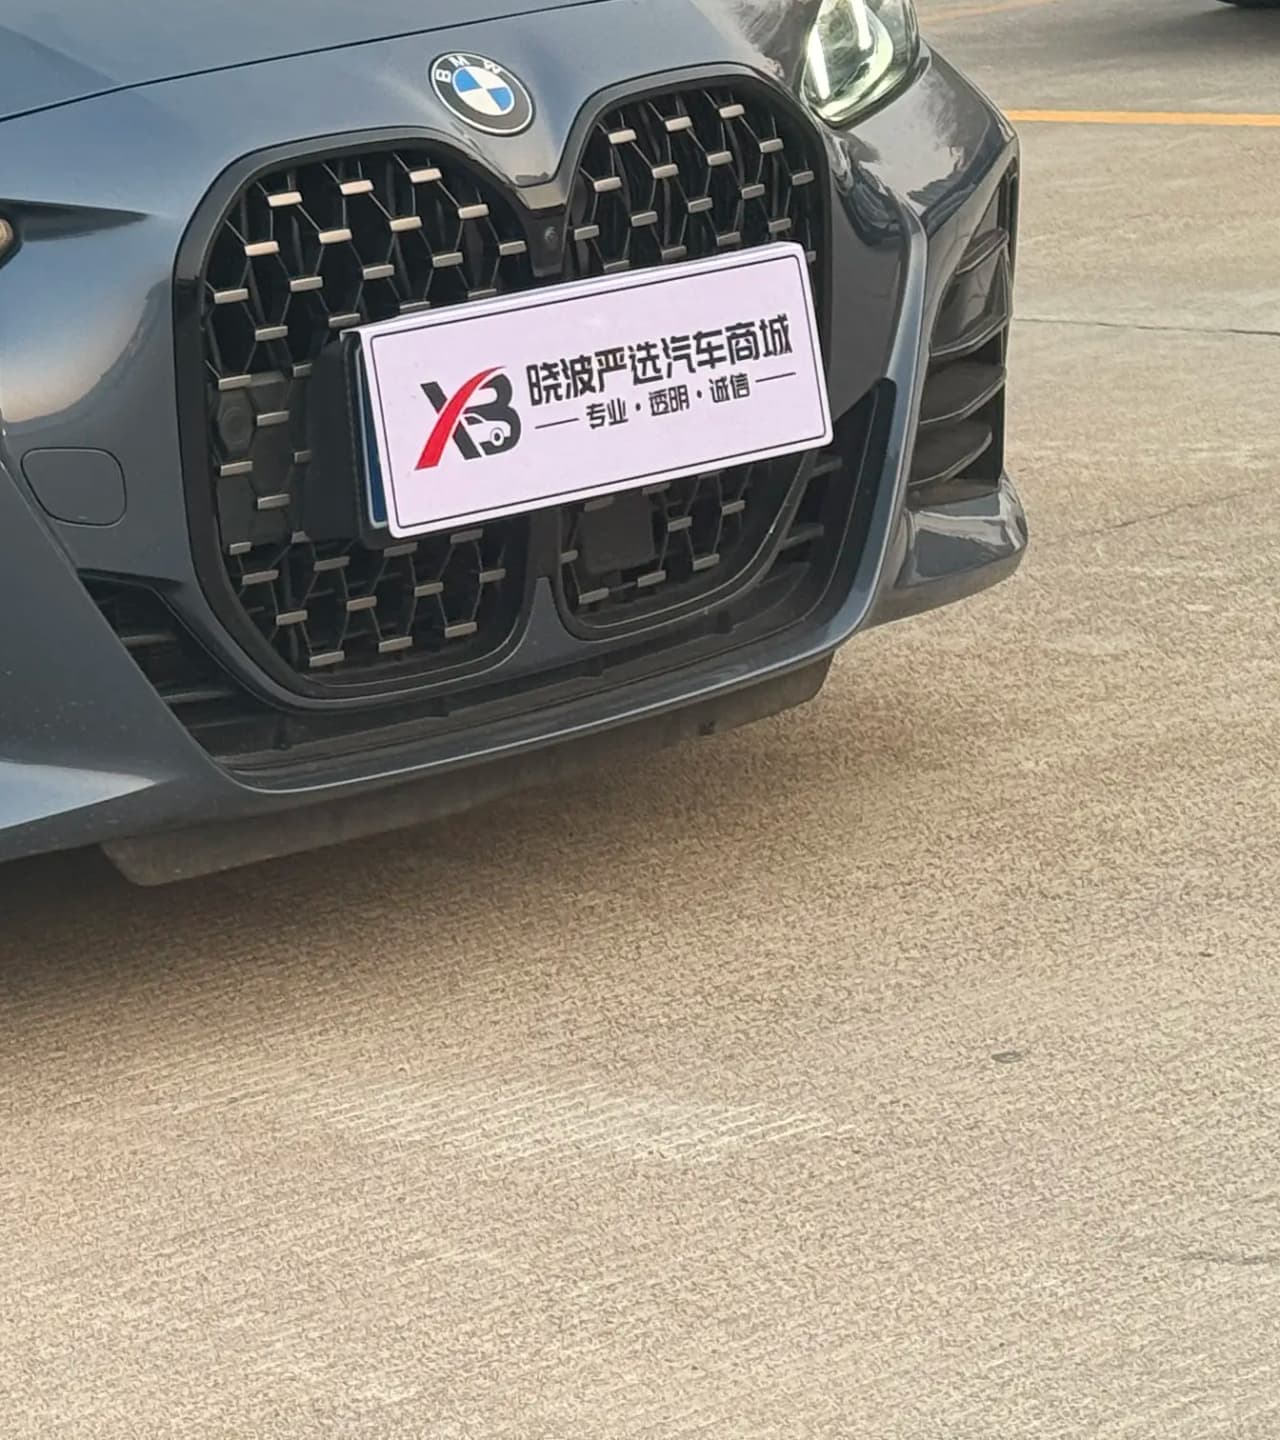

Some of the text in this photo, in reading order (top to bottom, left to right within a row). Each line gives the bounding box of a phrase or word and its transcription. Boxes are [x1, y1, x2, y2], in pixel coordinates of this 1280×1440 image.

[435, 55, 502, 84] BMW
[526, 313, 793, 406] 晓波严选汽车商城
